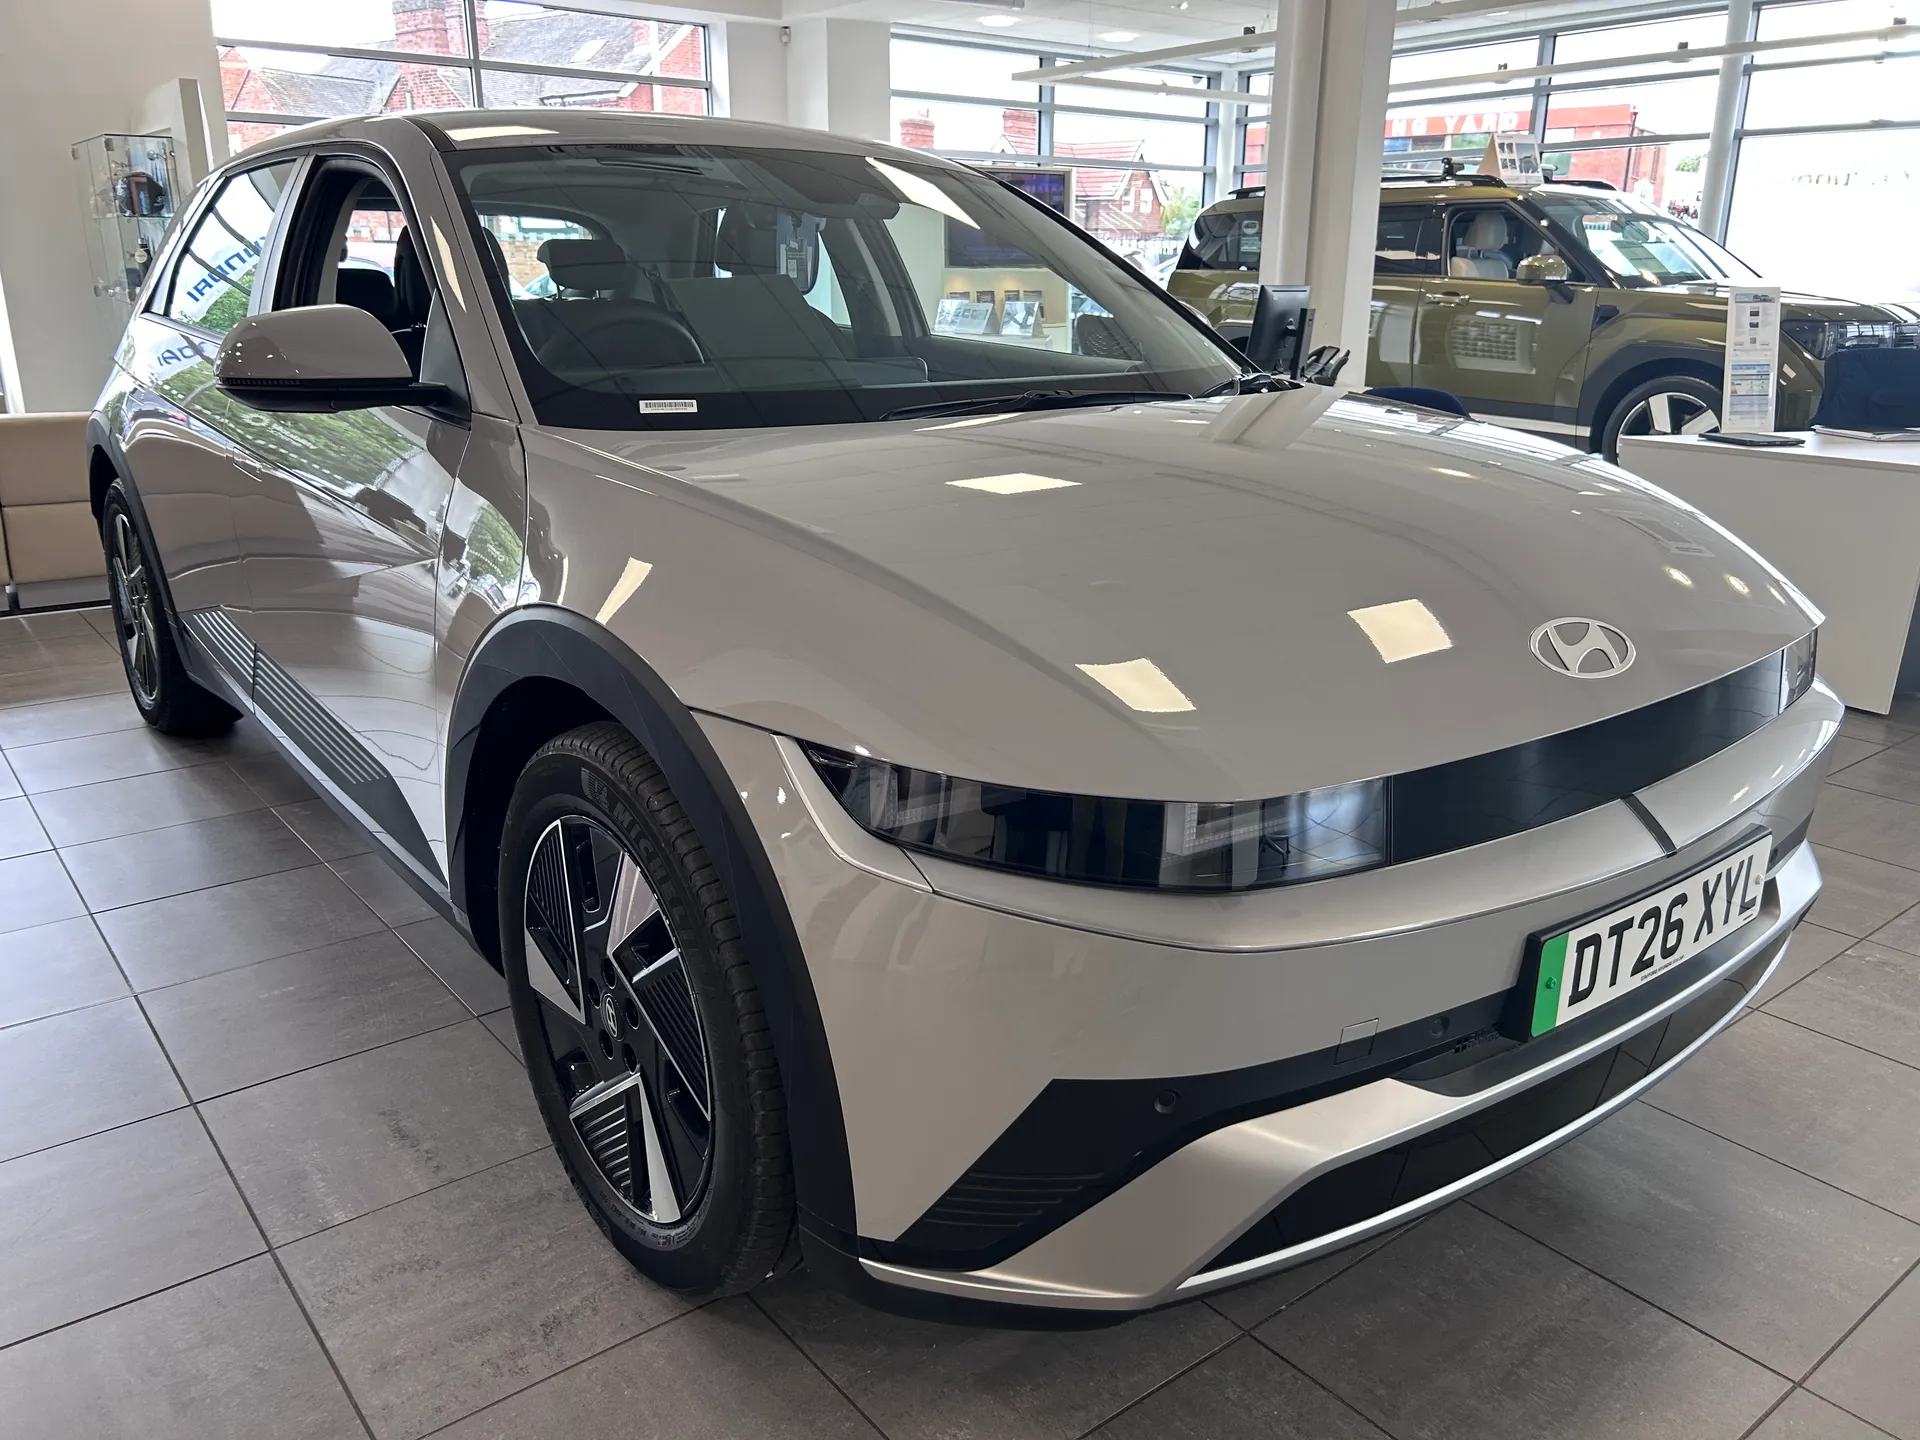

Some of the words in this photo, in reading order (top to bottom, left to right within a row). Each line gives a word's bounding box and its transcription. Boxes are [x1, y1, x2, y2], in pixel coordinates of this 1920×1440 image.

[1444, 111, 1518, 133] YARD
[1568, 892, 1688, 1007] DT26
[1693, 855, 1757, 943] XYL
